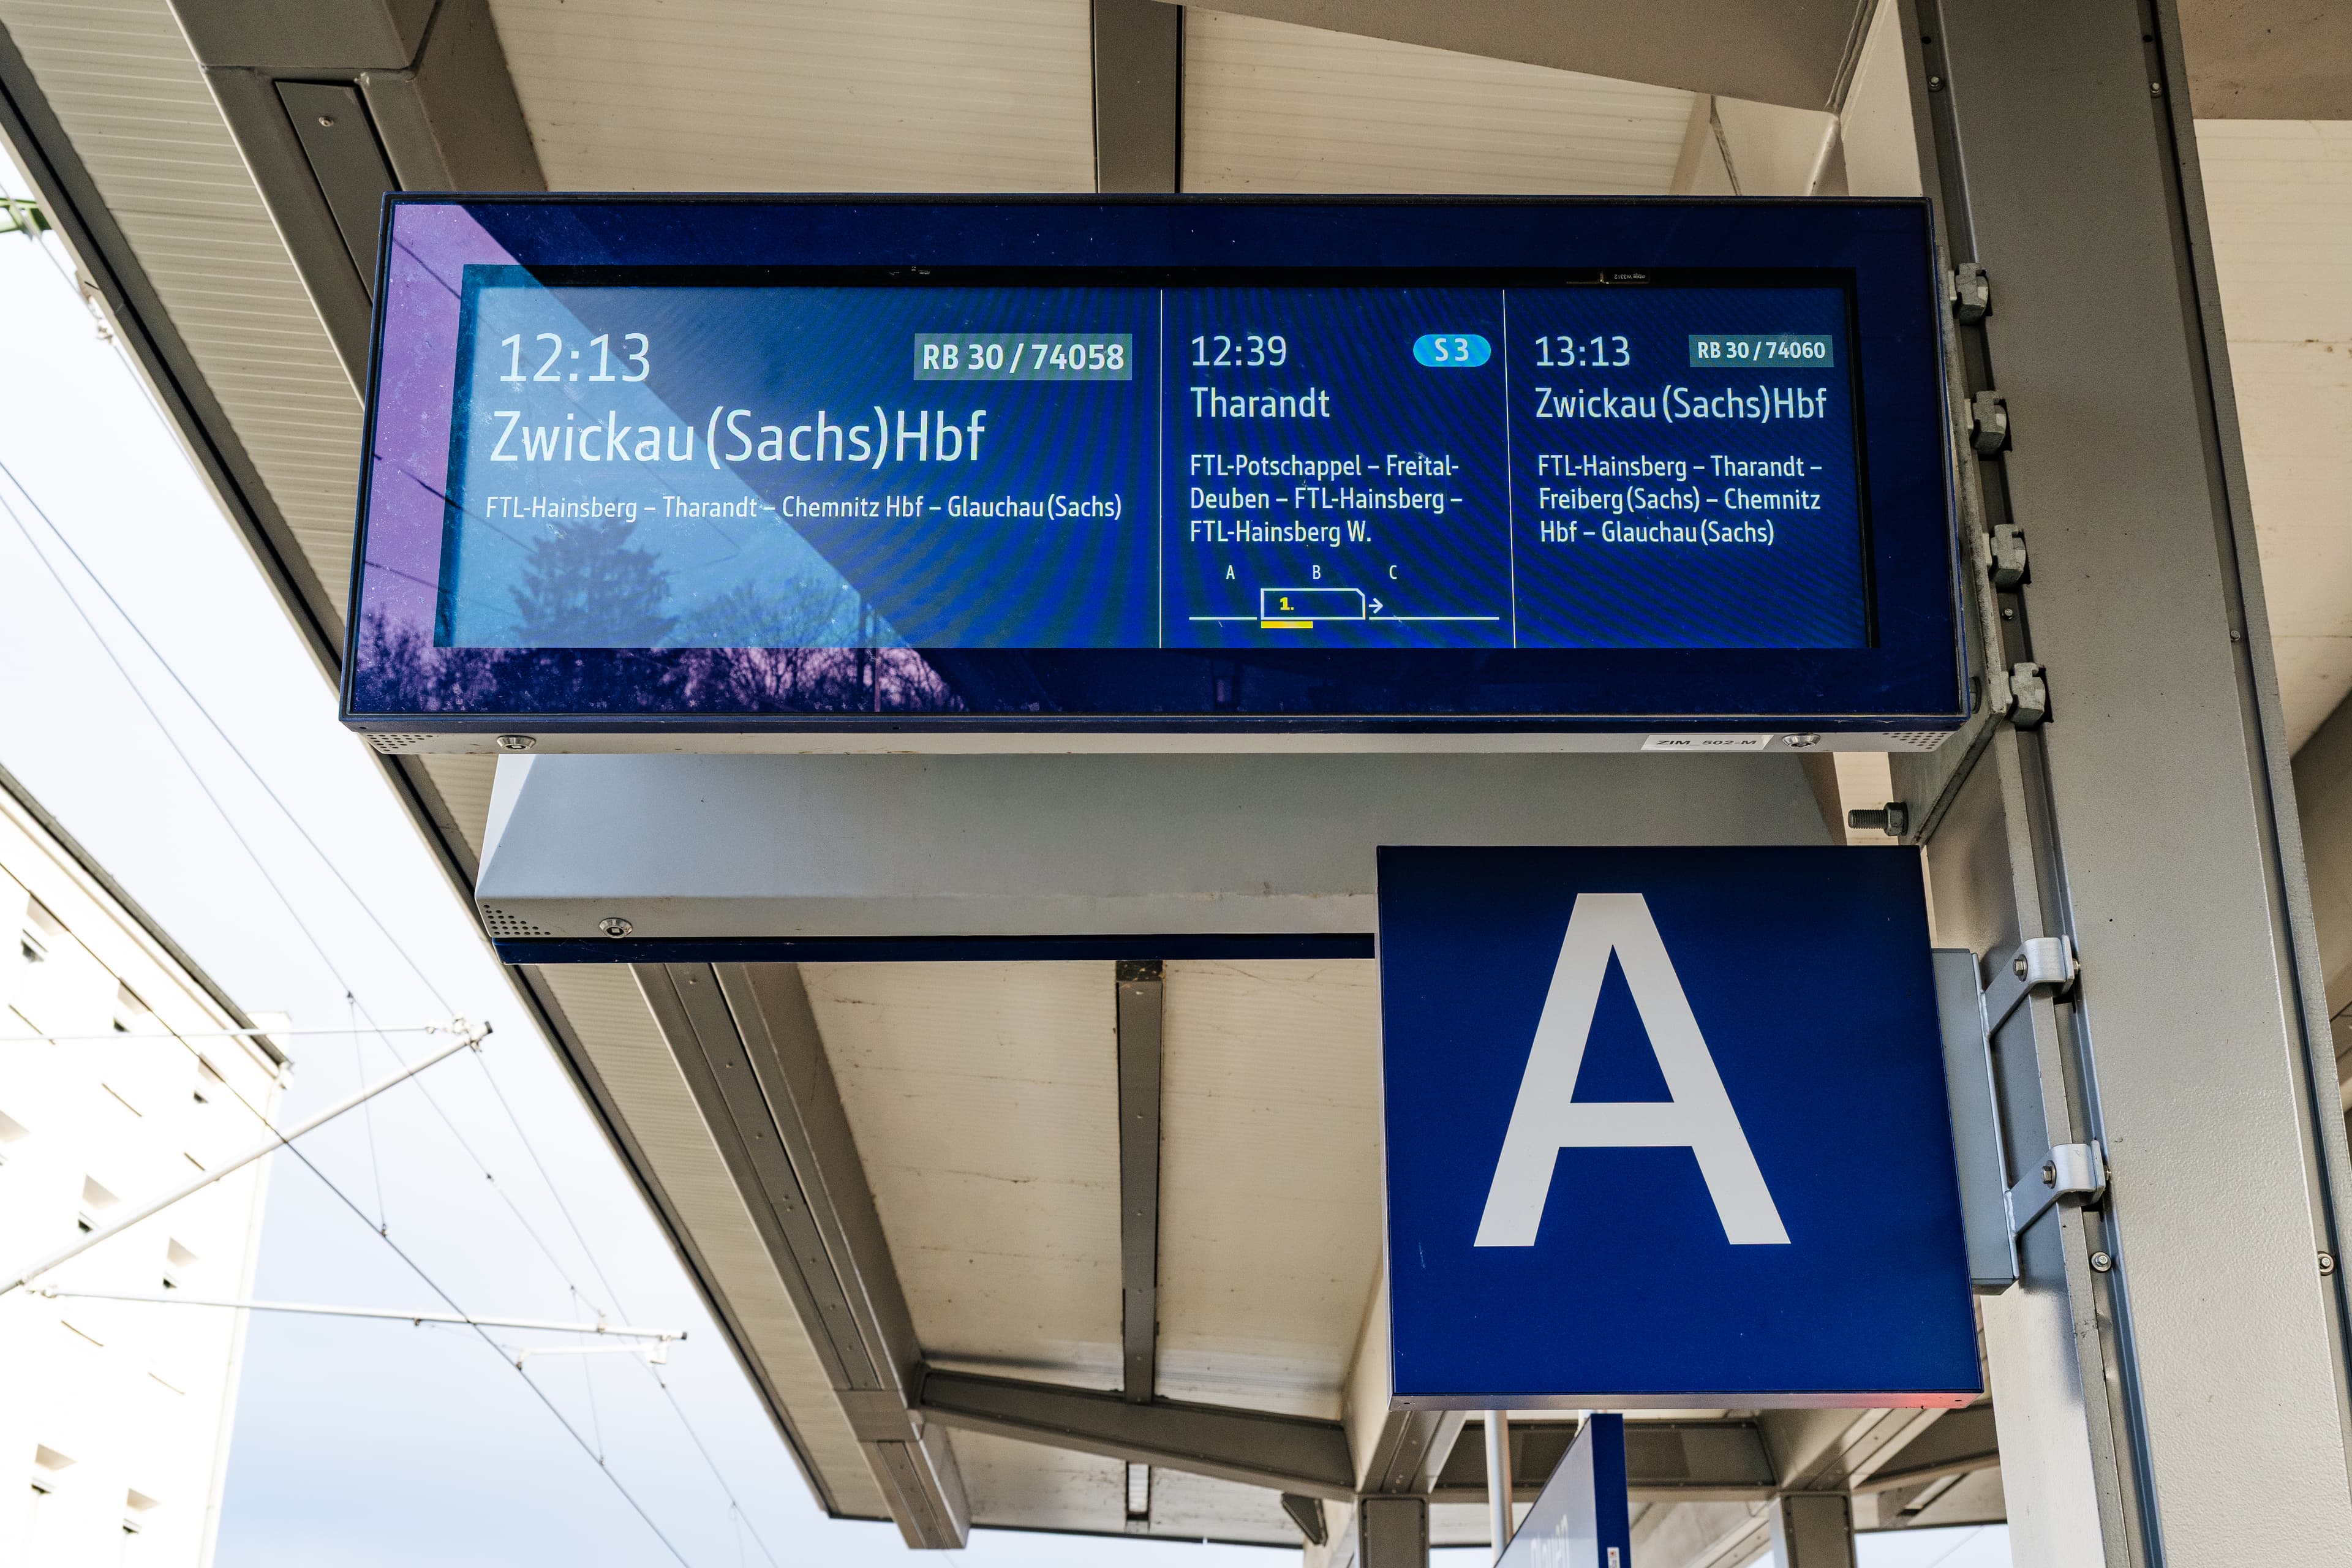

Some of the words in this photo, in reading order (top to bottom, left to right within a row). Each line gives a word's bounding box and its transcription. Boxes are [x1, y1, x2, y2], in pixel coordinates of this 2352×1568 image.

[500, 333, 650, 382] 12:13
[924, 344, 958, 369] RB
[969, 344, 1003, 369] 30
[1032, 344, 1123, 369] 74058
[1193, 336, 1286, 365] 12:39
[1435, 338, 1448, 361] S
[1455, 338, 1468, 361] 3
[1536, 336, 1629, 366] 13:13
[1698, 342, 1721, 358] RB
[1727, 342, 1749, 358] 30
[1766, 342, 1825, 358] 74060
[1191, 387, 1329, 417] Tharandt
[1191, 455, 1361, 481] FTL-Potschappel
[1387, 455, 1458, 475] Freital-
[1539, 455, 1687, 481] FTL-Hainsberg
[1711, 456, 1804, 476] Tharandt
[487, 497, 636, 522] FTL-Hainsberg
[663, 496, 756, 517] Tharandt
[783, 496, 879, 516] Chemnitz
[887, 496, 923, 516] Hbf
[1191, 488, 1268, 508] Deuben
[1296, 488, 1444, 514] FTL-Hainsberg
[1725, 488, 1820, 509] Chemnitz
[1191, 521, 1340, 547] FTL-Hainsberg
[1348, 521, 1371, 541] W.
[1542, 521, 1577, 541] Hbf
[1226, 565, 1235, 579] A
[1313, 565, 1321, 579] B
[1390, 565, 1396, 579] C
[1474, 892, 1792, 1247] A
